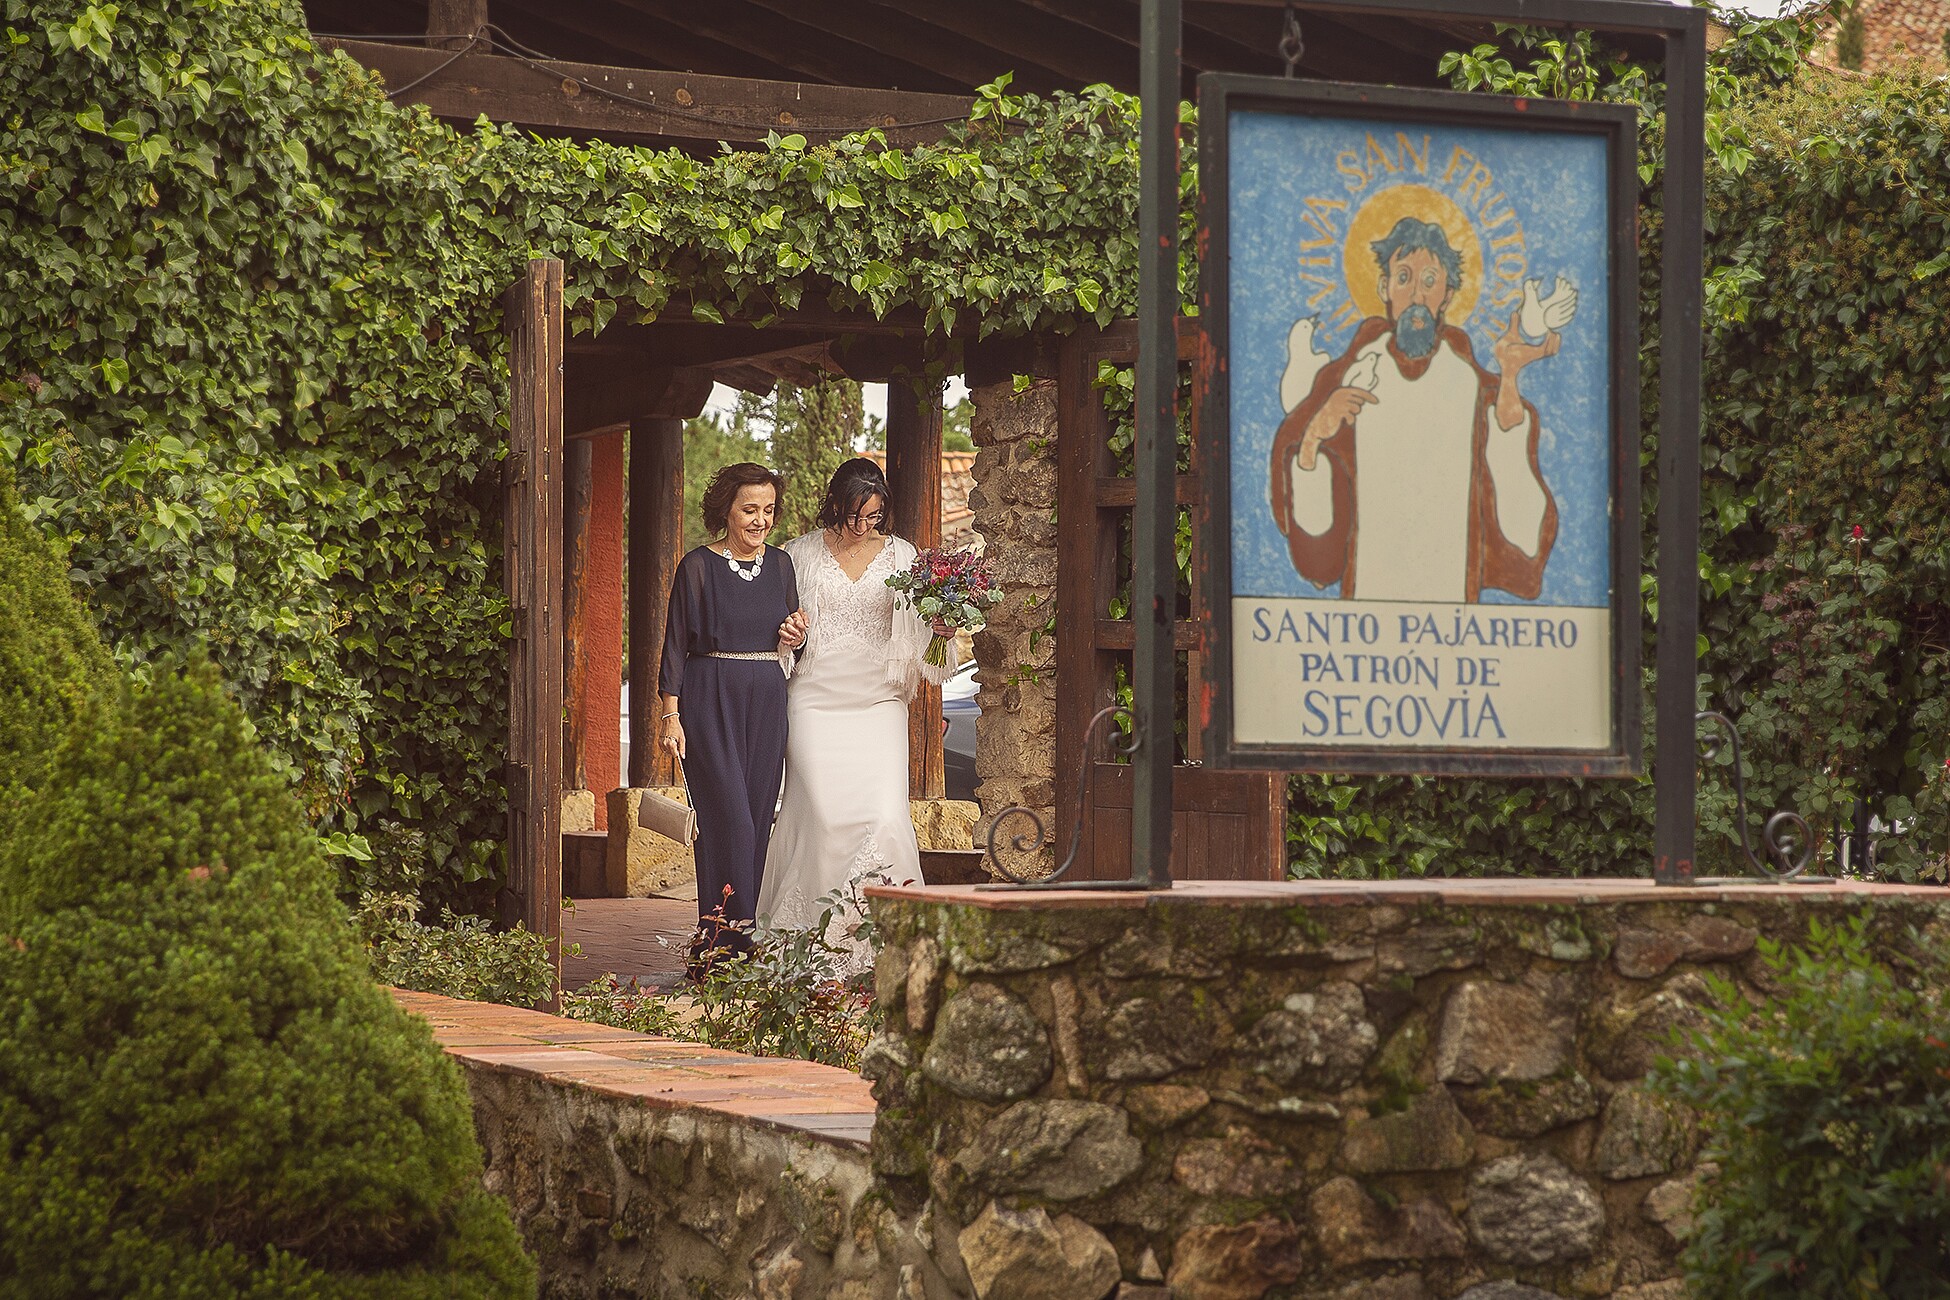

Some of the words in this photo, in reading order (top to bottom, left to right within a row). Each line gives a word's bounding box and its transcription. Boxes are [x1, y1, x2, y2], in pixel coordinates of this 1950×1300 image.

[1336, 131, 1431, 192] SAN
[1252, 607, 1379, 646] SANTO
[1299, 649, 1438, 691] PATRÓN
[1456, 656, 1500, 687] DE
